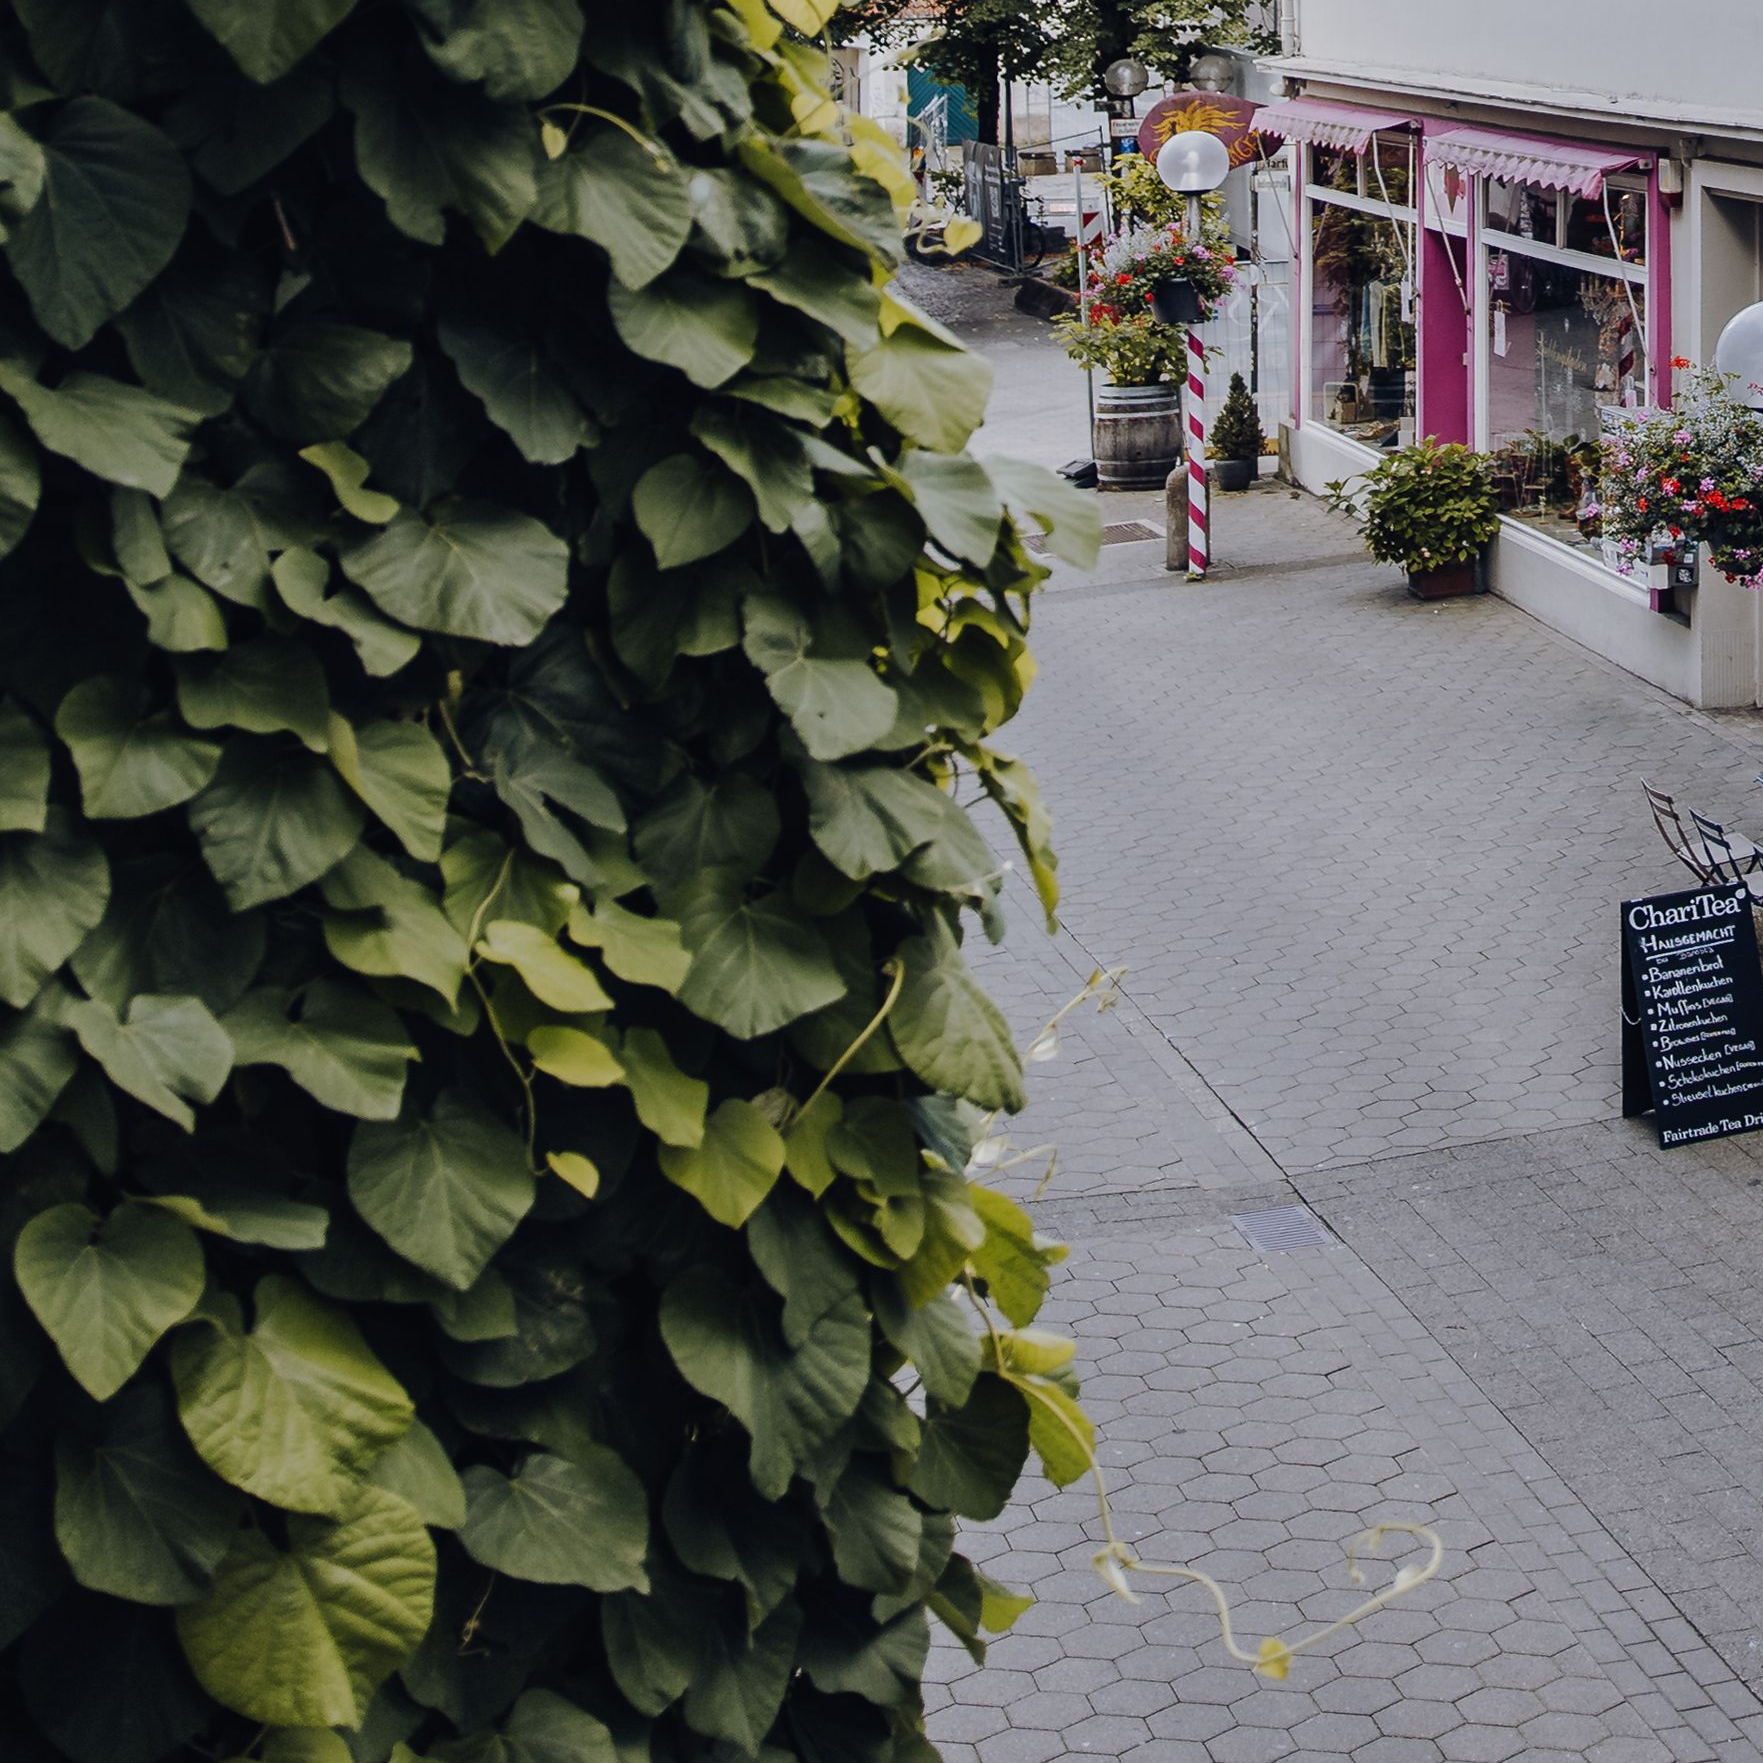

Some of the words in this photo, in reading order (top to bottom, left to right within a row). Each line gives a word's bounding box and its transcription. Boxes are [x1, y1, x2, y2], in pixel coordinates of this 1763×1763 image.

[1628, 894, 1741, 931] ChariTea
[1649, 954, 1724, 983] Bananenbrot
[1652, 976, 1734, 999] Karottenkuchen
[1657, 999, 1702, 1017] Muffins
[1662, 1048, 1722, 1070] Nussecken
[1663, 1122, 1719, 1143] Fairtrade
[1720, 1117, 1742, 1132] Tea
